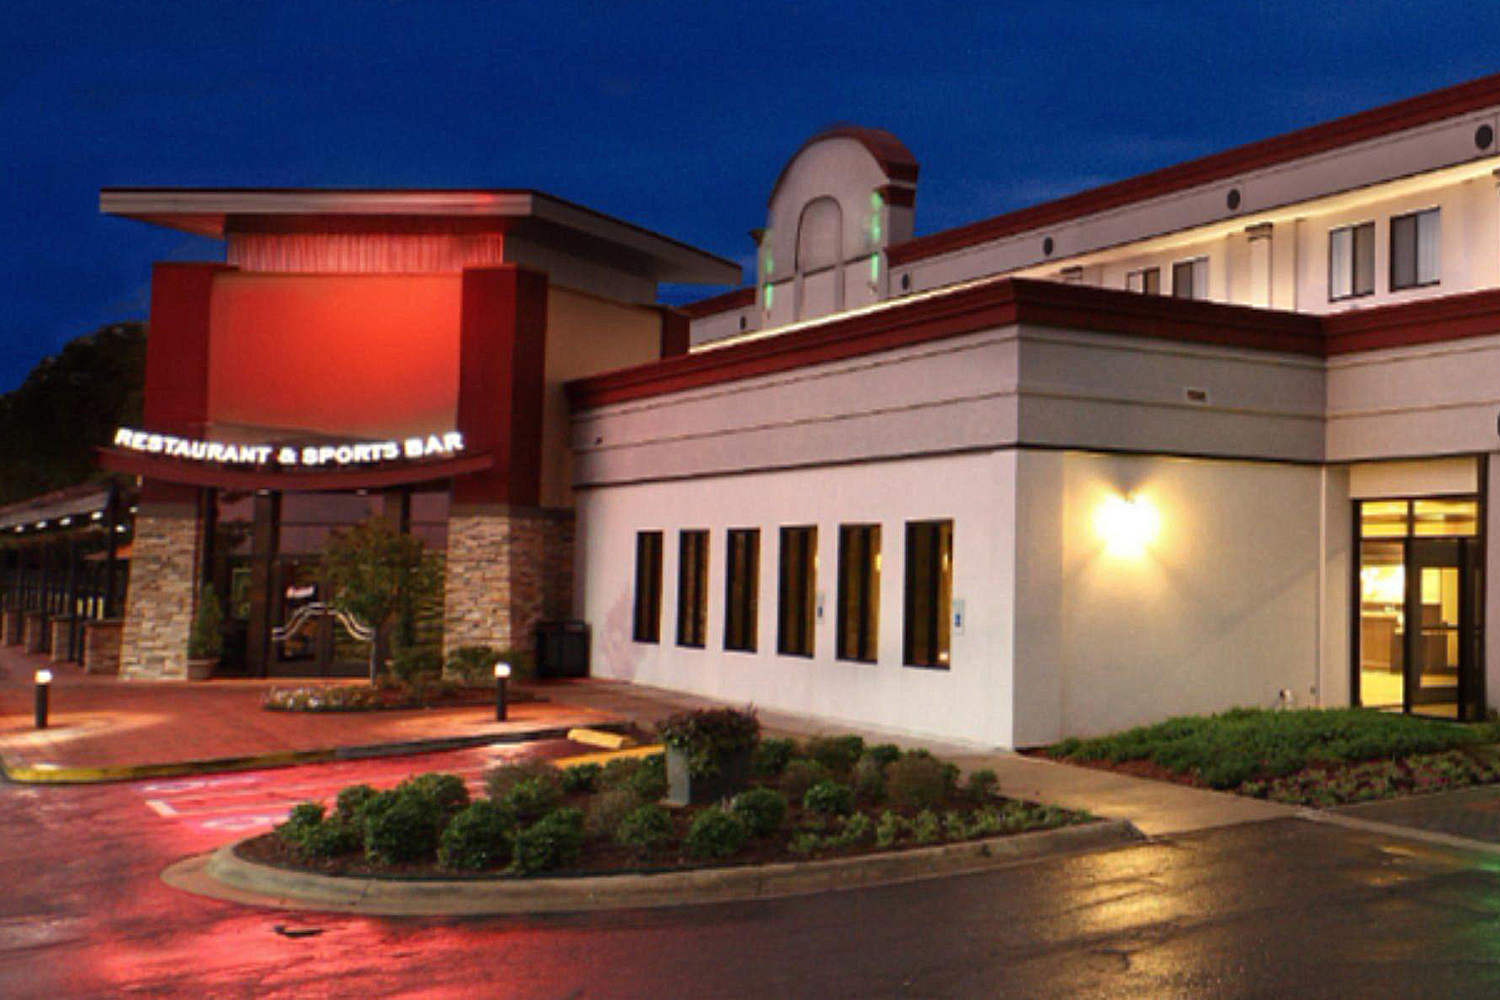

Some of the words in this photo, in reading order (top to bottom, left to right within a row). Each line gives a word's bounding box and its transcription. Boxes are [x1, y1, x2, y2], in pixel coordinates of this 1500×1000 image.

[114, 427, 272, 464] RESTAURANT
[277, 446, 297, 465] &
[302, 440, 399, 465] SPORTS
[404, 431, 464, 458] BAR
